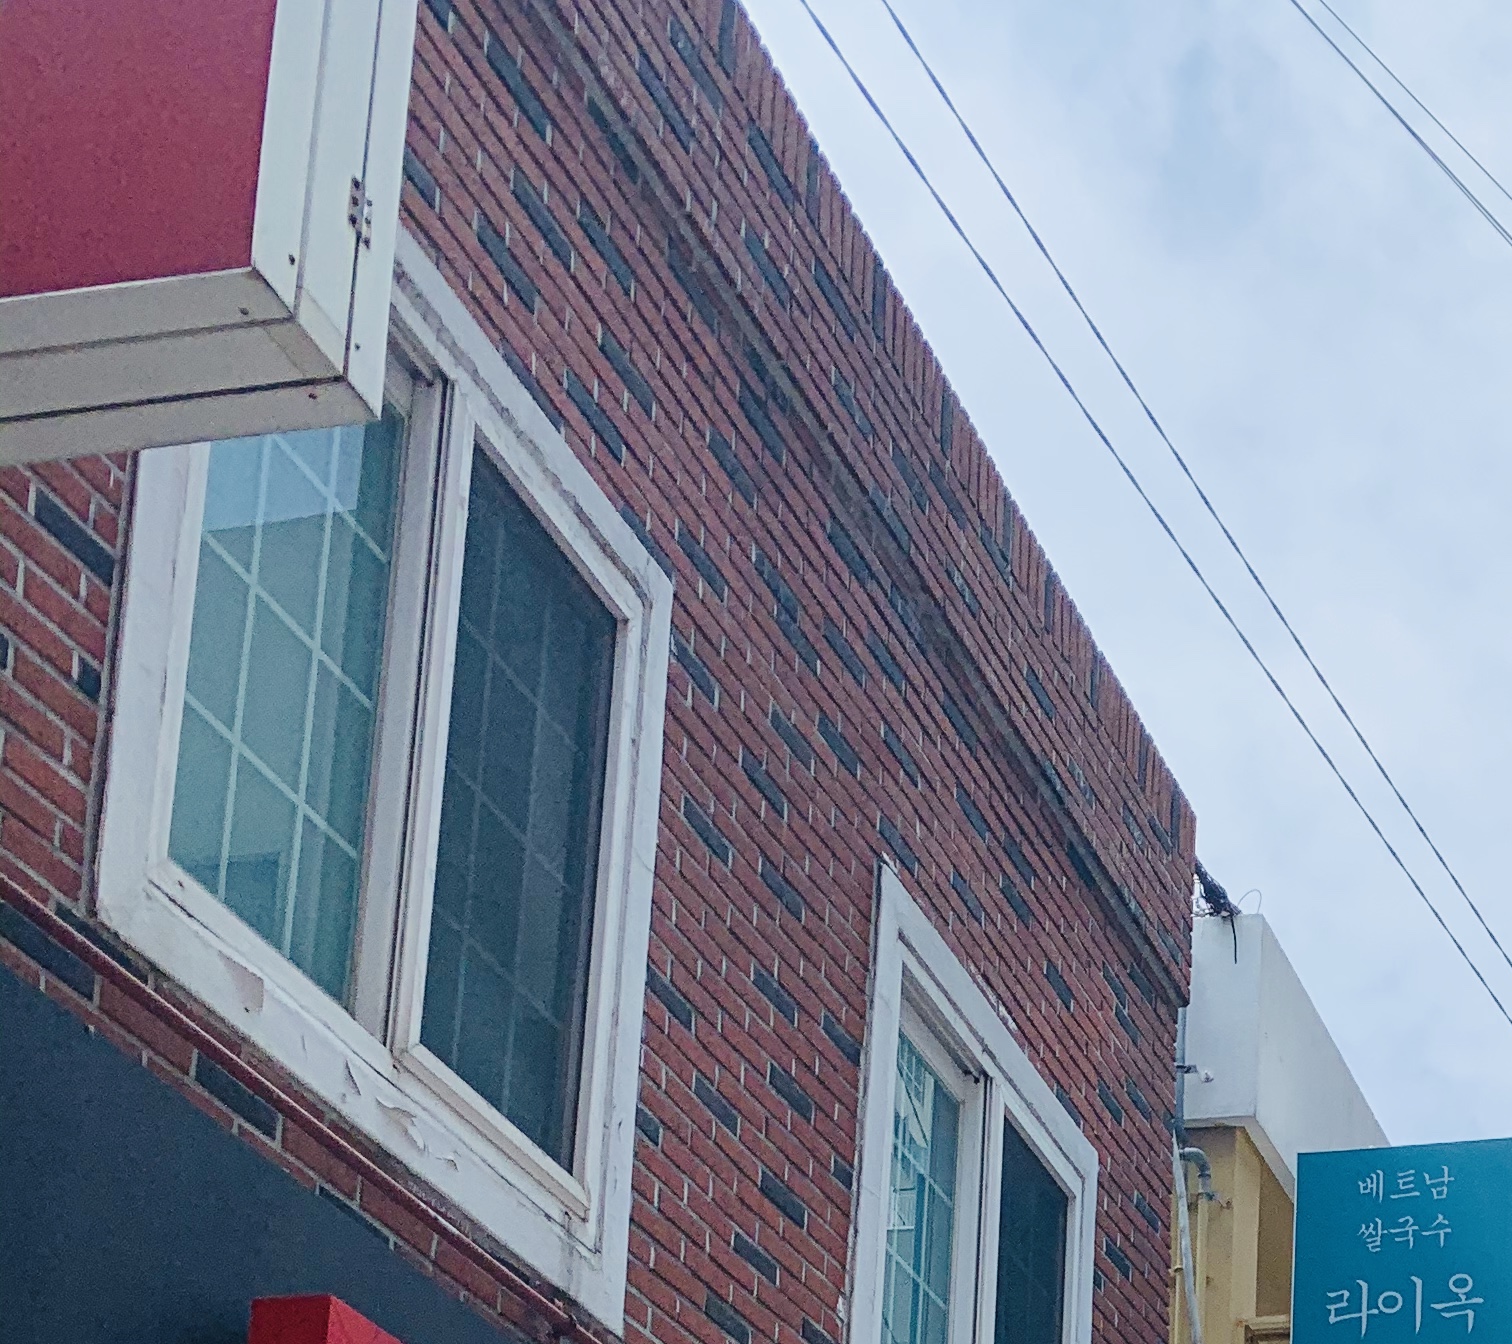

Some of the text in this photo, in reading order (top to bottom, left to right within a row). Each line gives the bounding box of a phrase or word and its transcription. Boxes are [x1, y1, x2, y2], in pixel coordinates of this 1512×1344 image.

[1356, 1164, 1456, 1201] 베트남
[1356, 1213, 1453, 1254] 쌀국수
[1325, 1273, 1485, 1339] 라이옥
